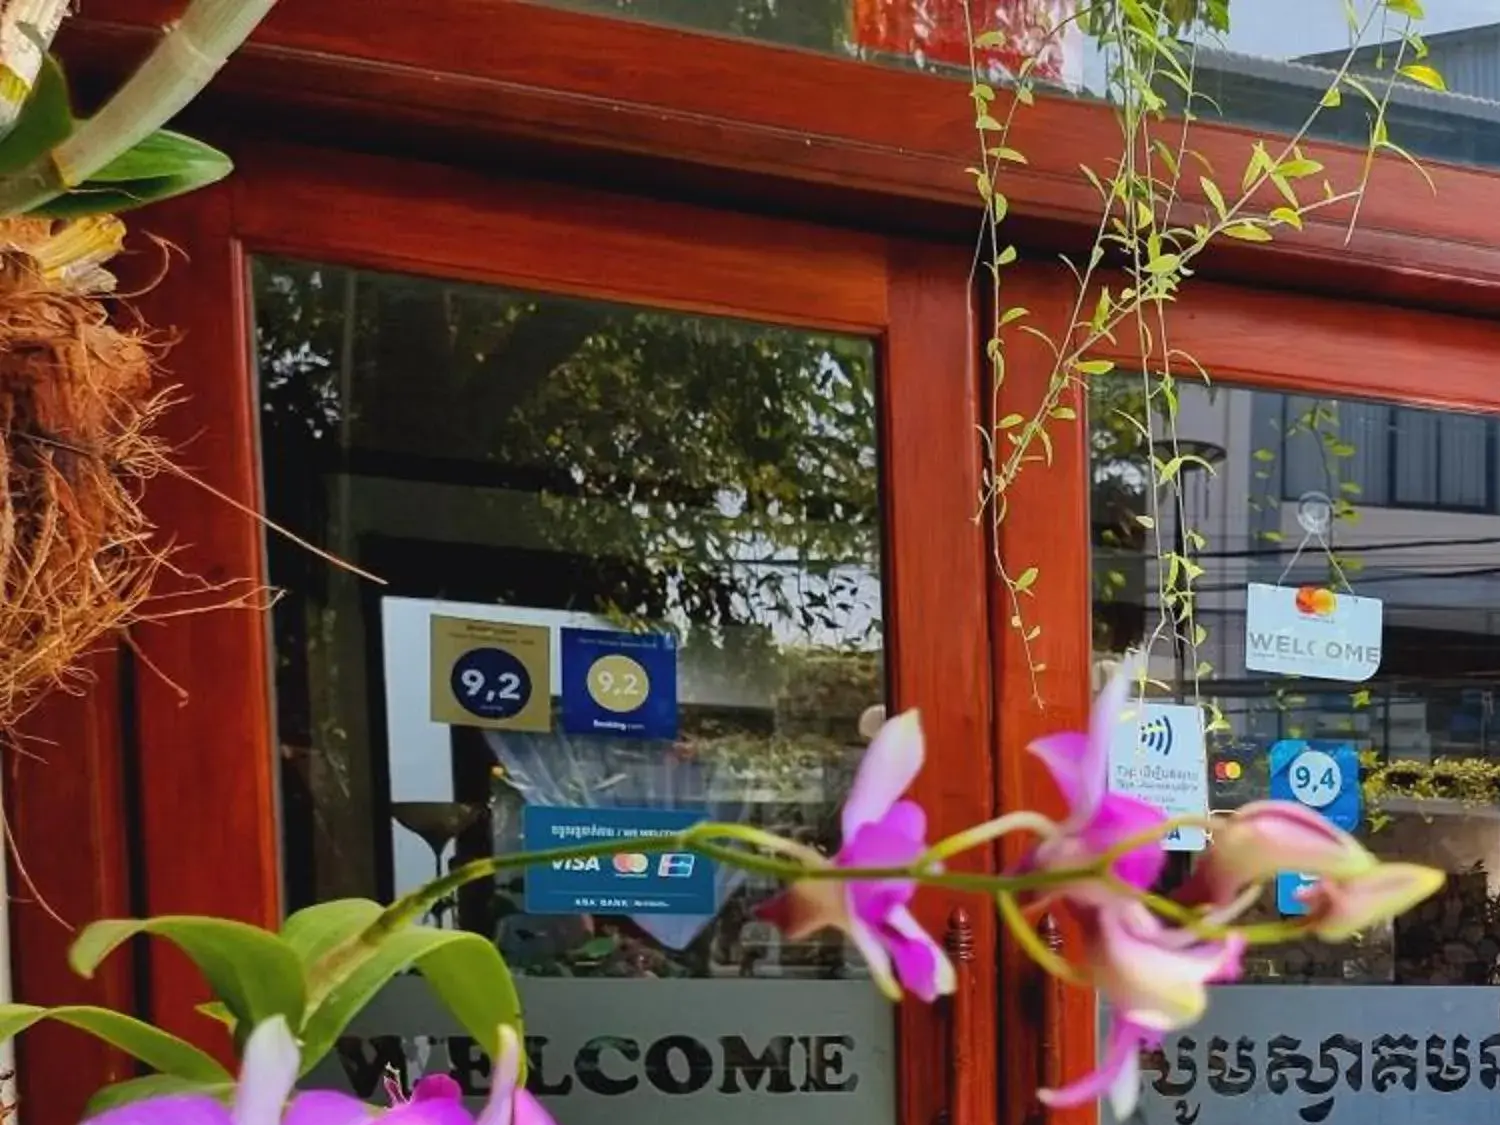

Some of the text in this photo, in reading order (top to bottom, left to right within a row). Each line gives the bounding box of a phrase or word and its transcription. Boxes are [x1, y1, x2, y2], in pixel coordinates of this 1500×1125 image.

[460, 668, 521, 702] 9,2
[1295, 765, 1336, 792] 9,4
[552, 855, 600, 872] VISA
[336, 1034, 859, 1098] WELCOME
